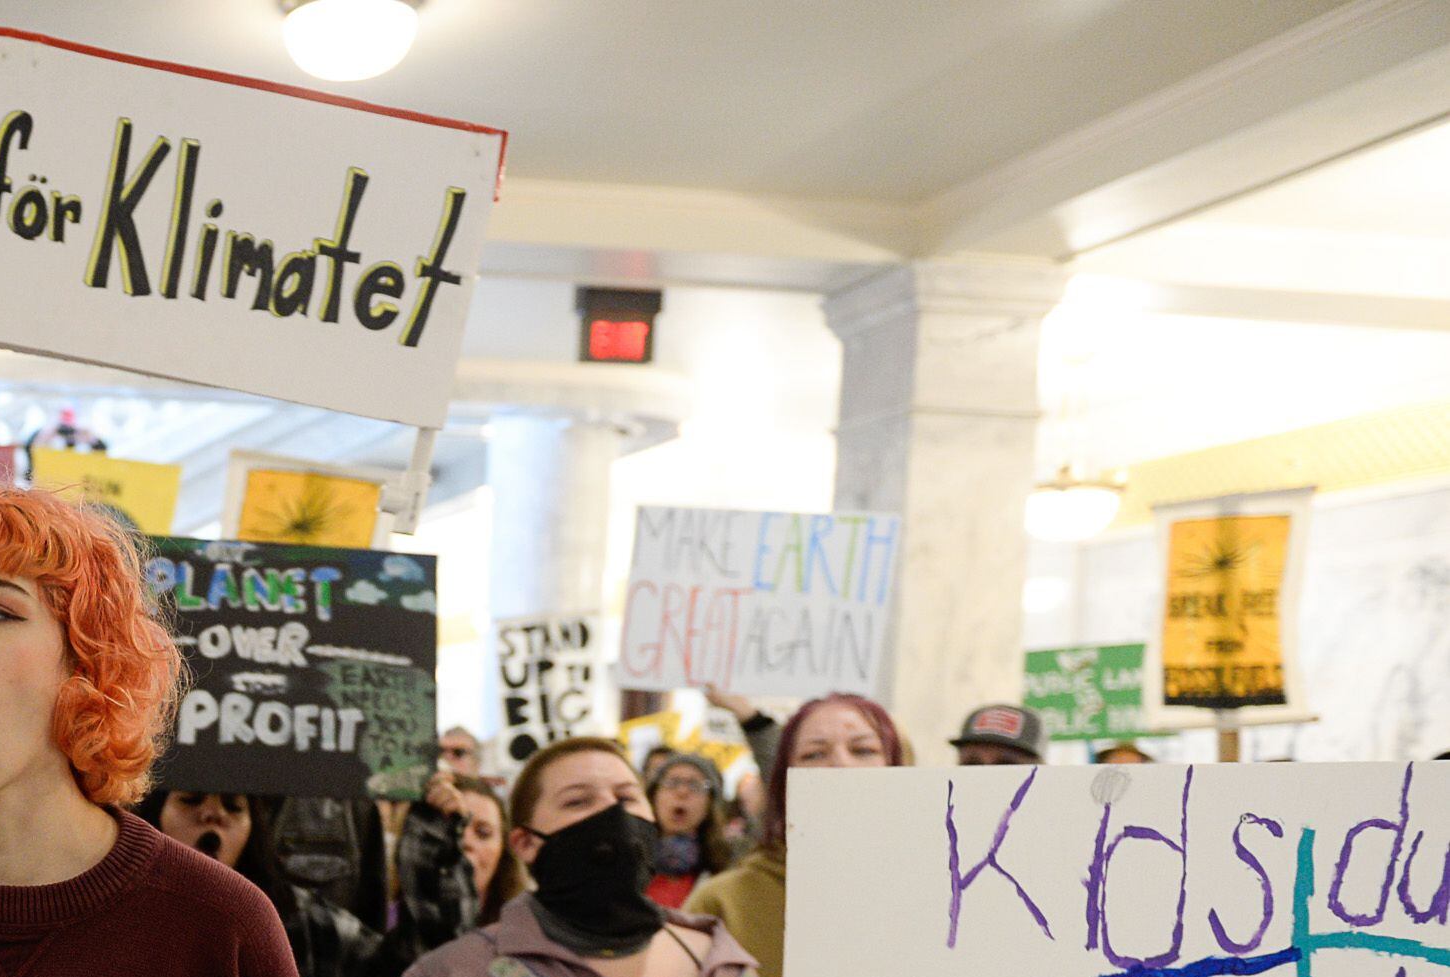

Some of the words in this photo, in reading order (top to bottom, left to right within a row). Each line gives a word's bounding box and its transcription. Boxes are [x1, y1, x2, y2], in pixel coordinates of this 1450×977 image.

[83, 117, 466, 348] Klimatet
[145, 557, 342, 621] PLANET
[637, 506, 742, 579] MAKE
[752, 511, 898, 607] EARTH
[198, 621, 310, 667] OVER
[619, 579, 755, 691] GREAT
[736, 606, 874, 681] AGAIN
[176, 689, 365, 752] PROFIT
